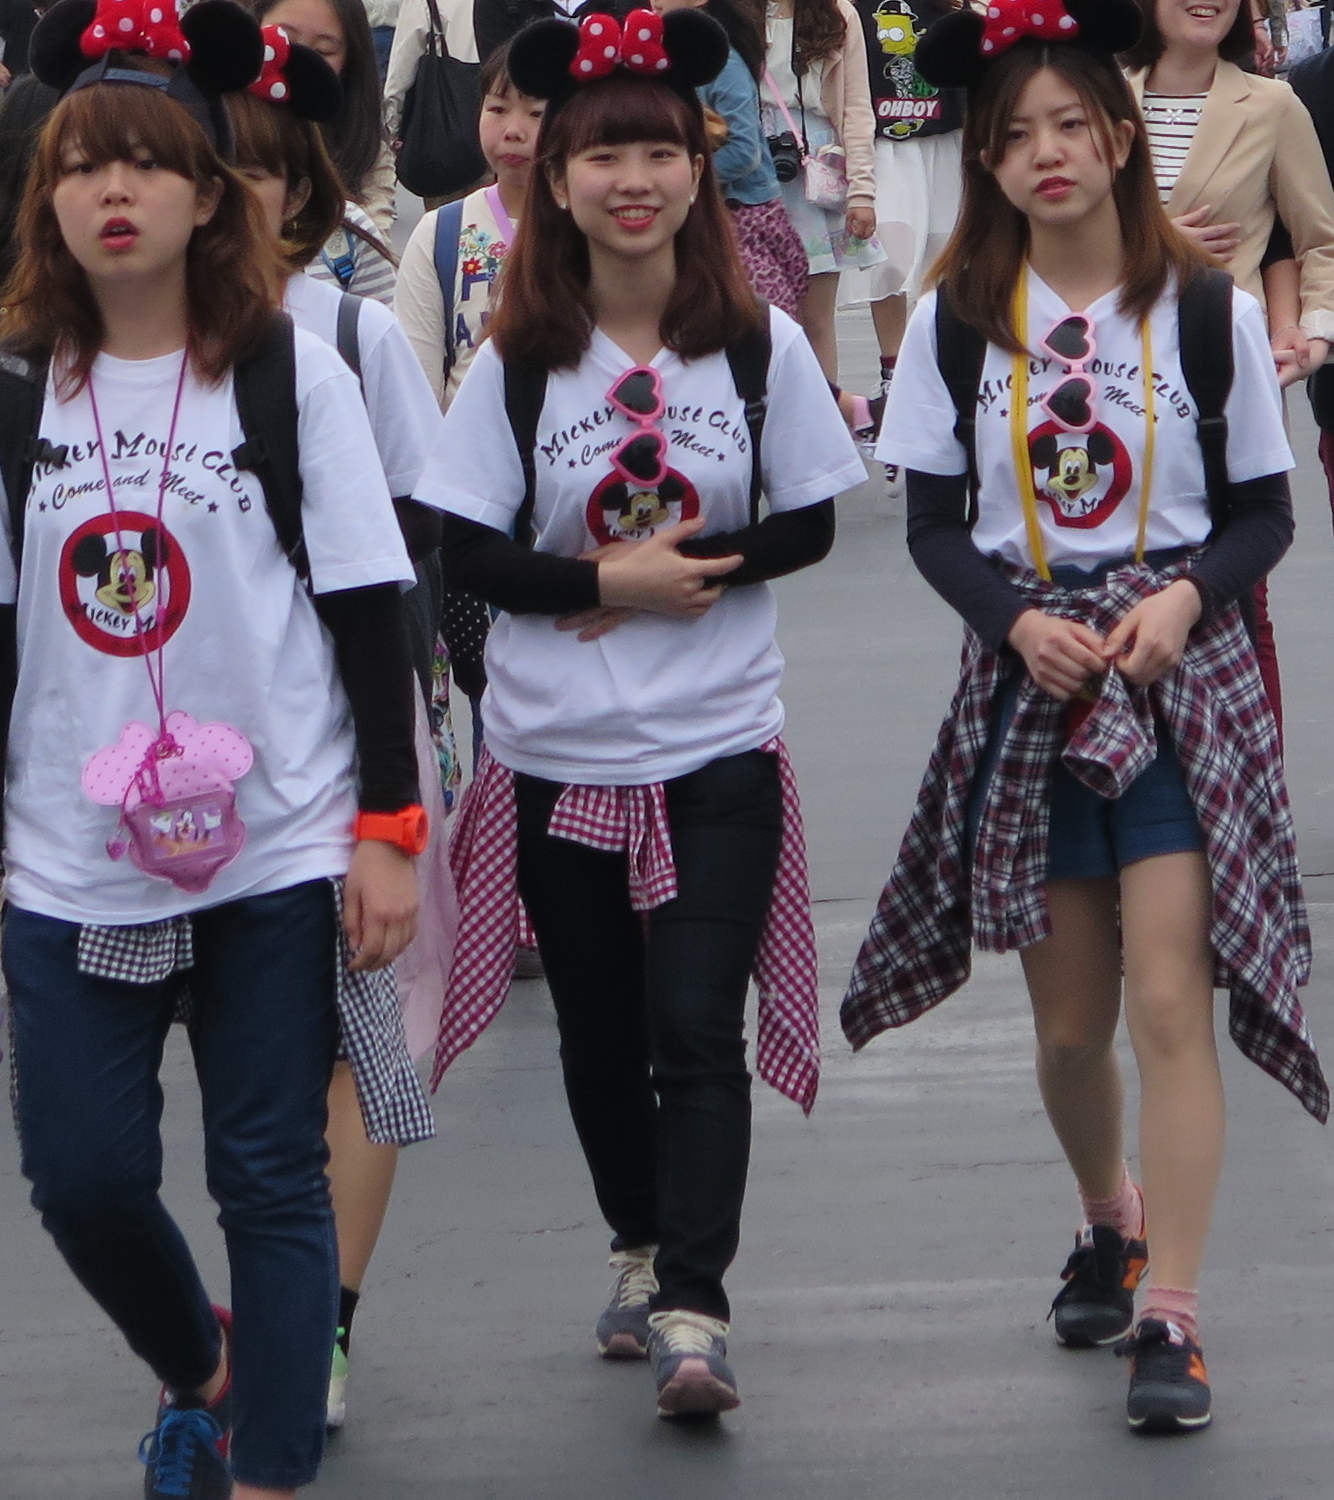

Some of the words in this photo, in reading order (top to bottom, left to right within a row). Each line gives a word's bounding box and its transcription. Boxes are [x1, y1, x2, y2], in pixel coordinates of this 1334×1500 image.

[878, 100, 938, 118] OHBOY
[978, 357, 1052, 414] MICEY
[1063, 358, 1139, 381] OUSE
[1104, 385, 1147, 417] Meet
[671, 429, 715, 457] Meet
[52, 483, 106, 510] Come
[113, 468, 151, 487] and
[159, 471, 205, 505] Meet
[111, 429, 198, 462] MOUSE
[202, 451, 251, 513] CLUB
